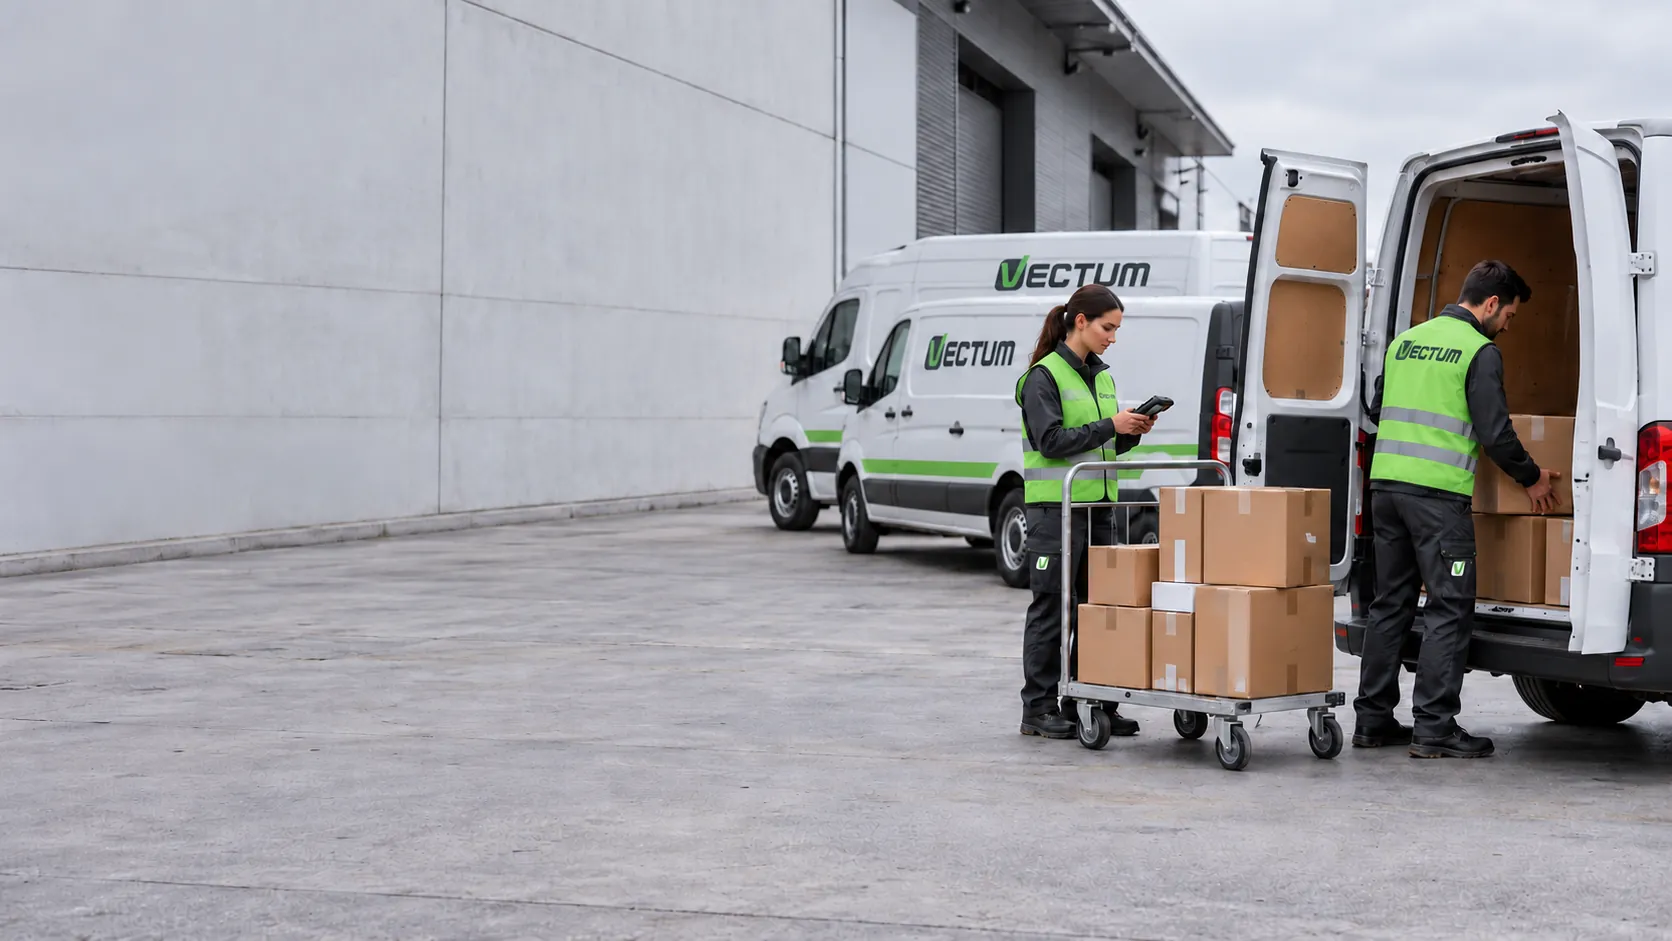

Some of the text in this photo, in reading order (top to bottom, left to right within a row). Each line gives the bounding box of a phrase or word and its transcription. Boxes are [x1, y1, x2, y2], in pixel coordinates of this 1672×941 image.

[995, 254, 1151, 291] VECTUM
[924, 333, 1016, 370] VECTUM
[1395, 340, 1462, 364] VECTUM
